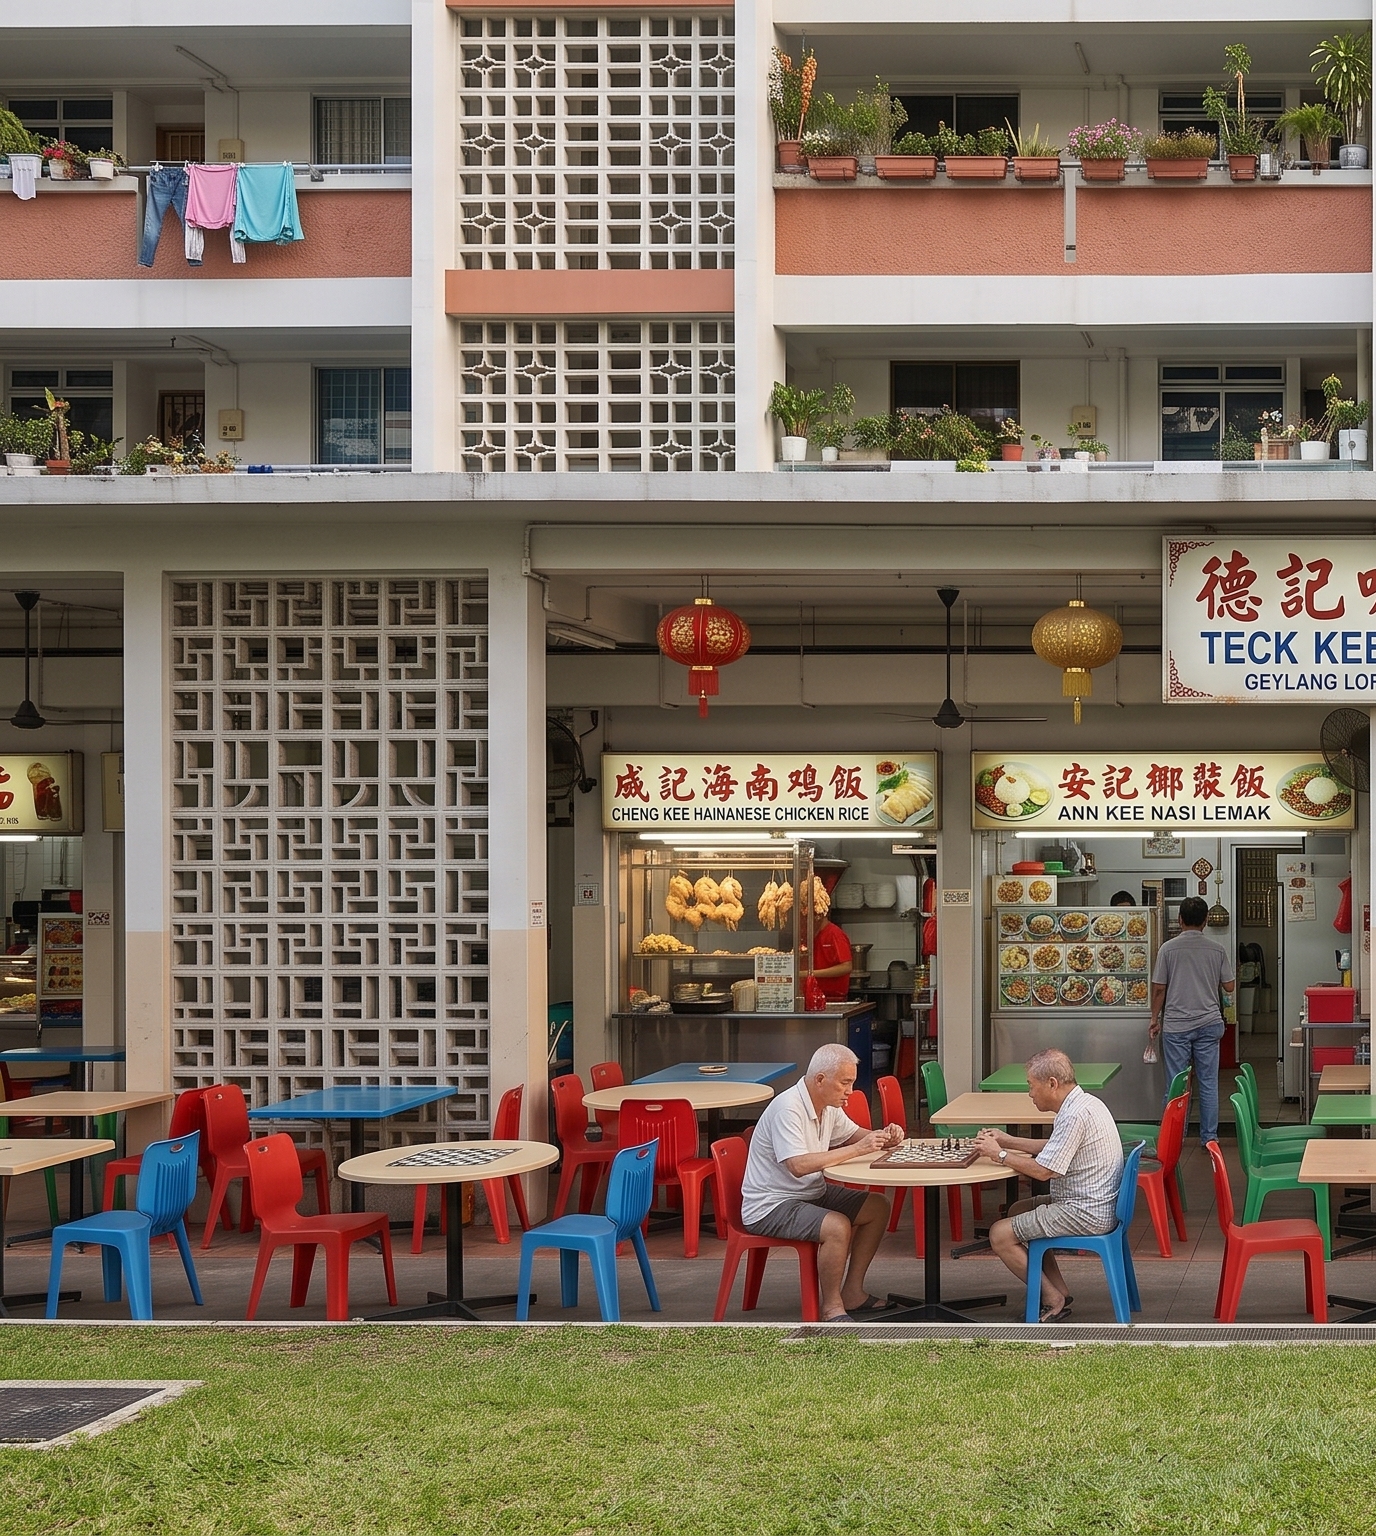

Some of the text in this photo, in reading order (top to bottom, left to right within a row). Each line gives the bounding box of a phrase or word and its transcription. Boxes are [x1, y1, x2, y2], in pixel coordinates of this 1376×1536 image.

[1201, 631, 1298, 664] TECK
[1245, 673, 1337, 691] GEYLANG
[612, 807, 869, 821] CHENG KEE HAINANESE CHICKEN RICE
[1057, 805, 1271, 821] ANN KEE NASI LEMAK
